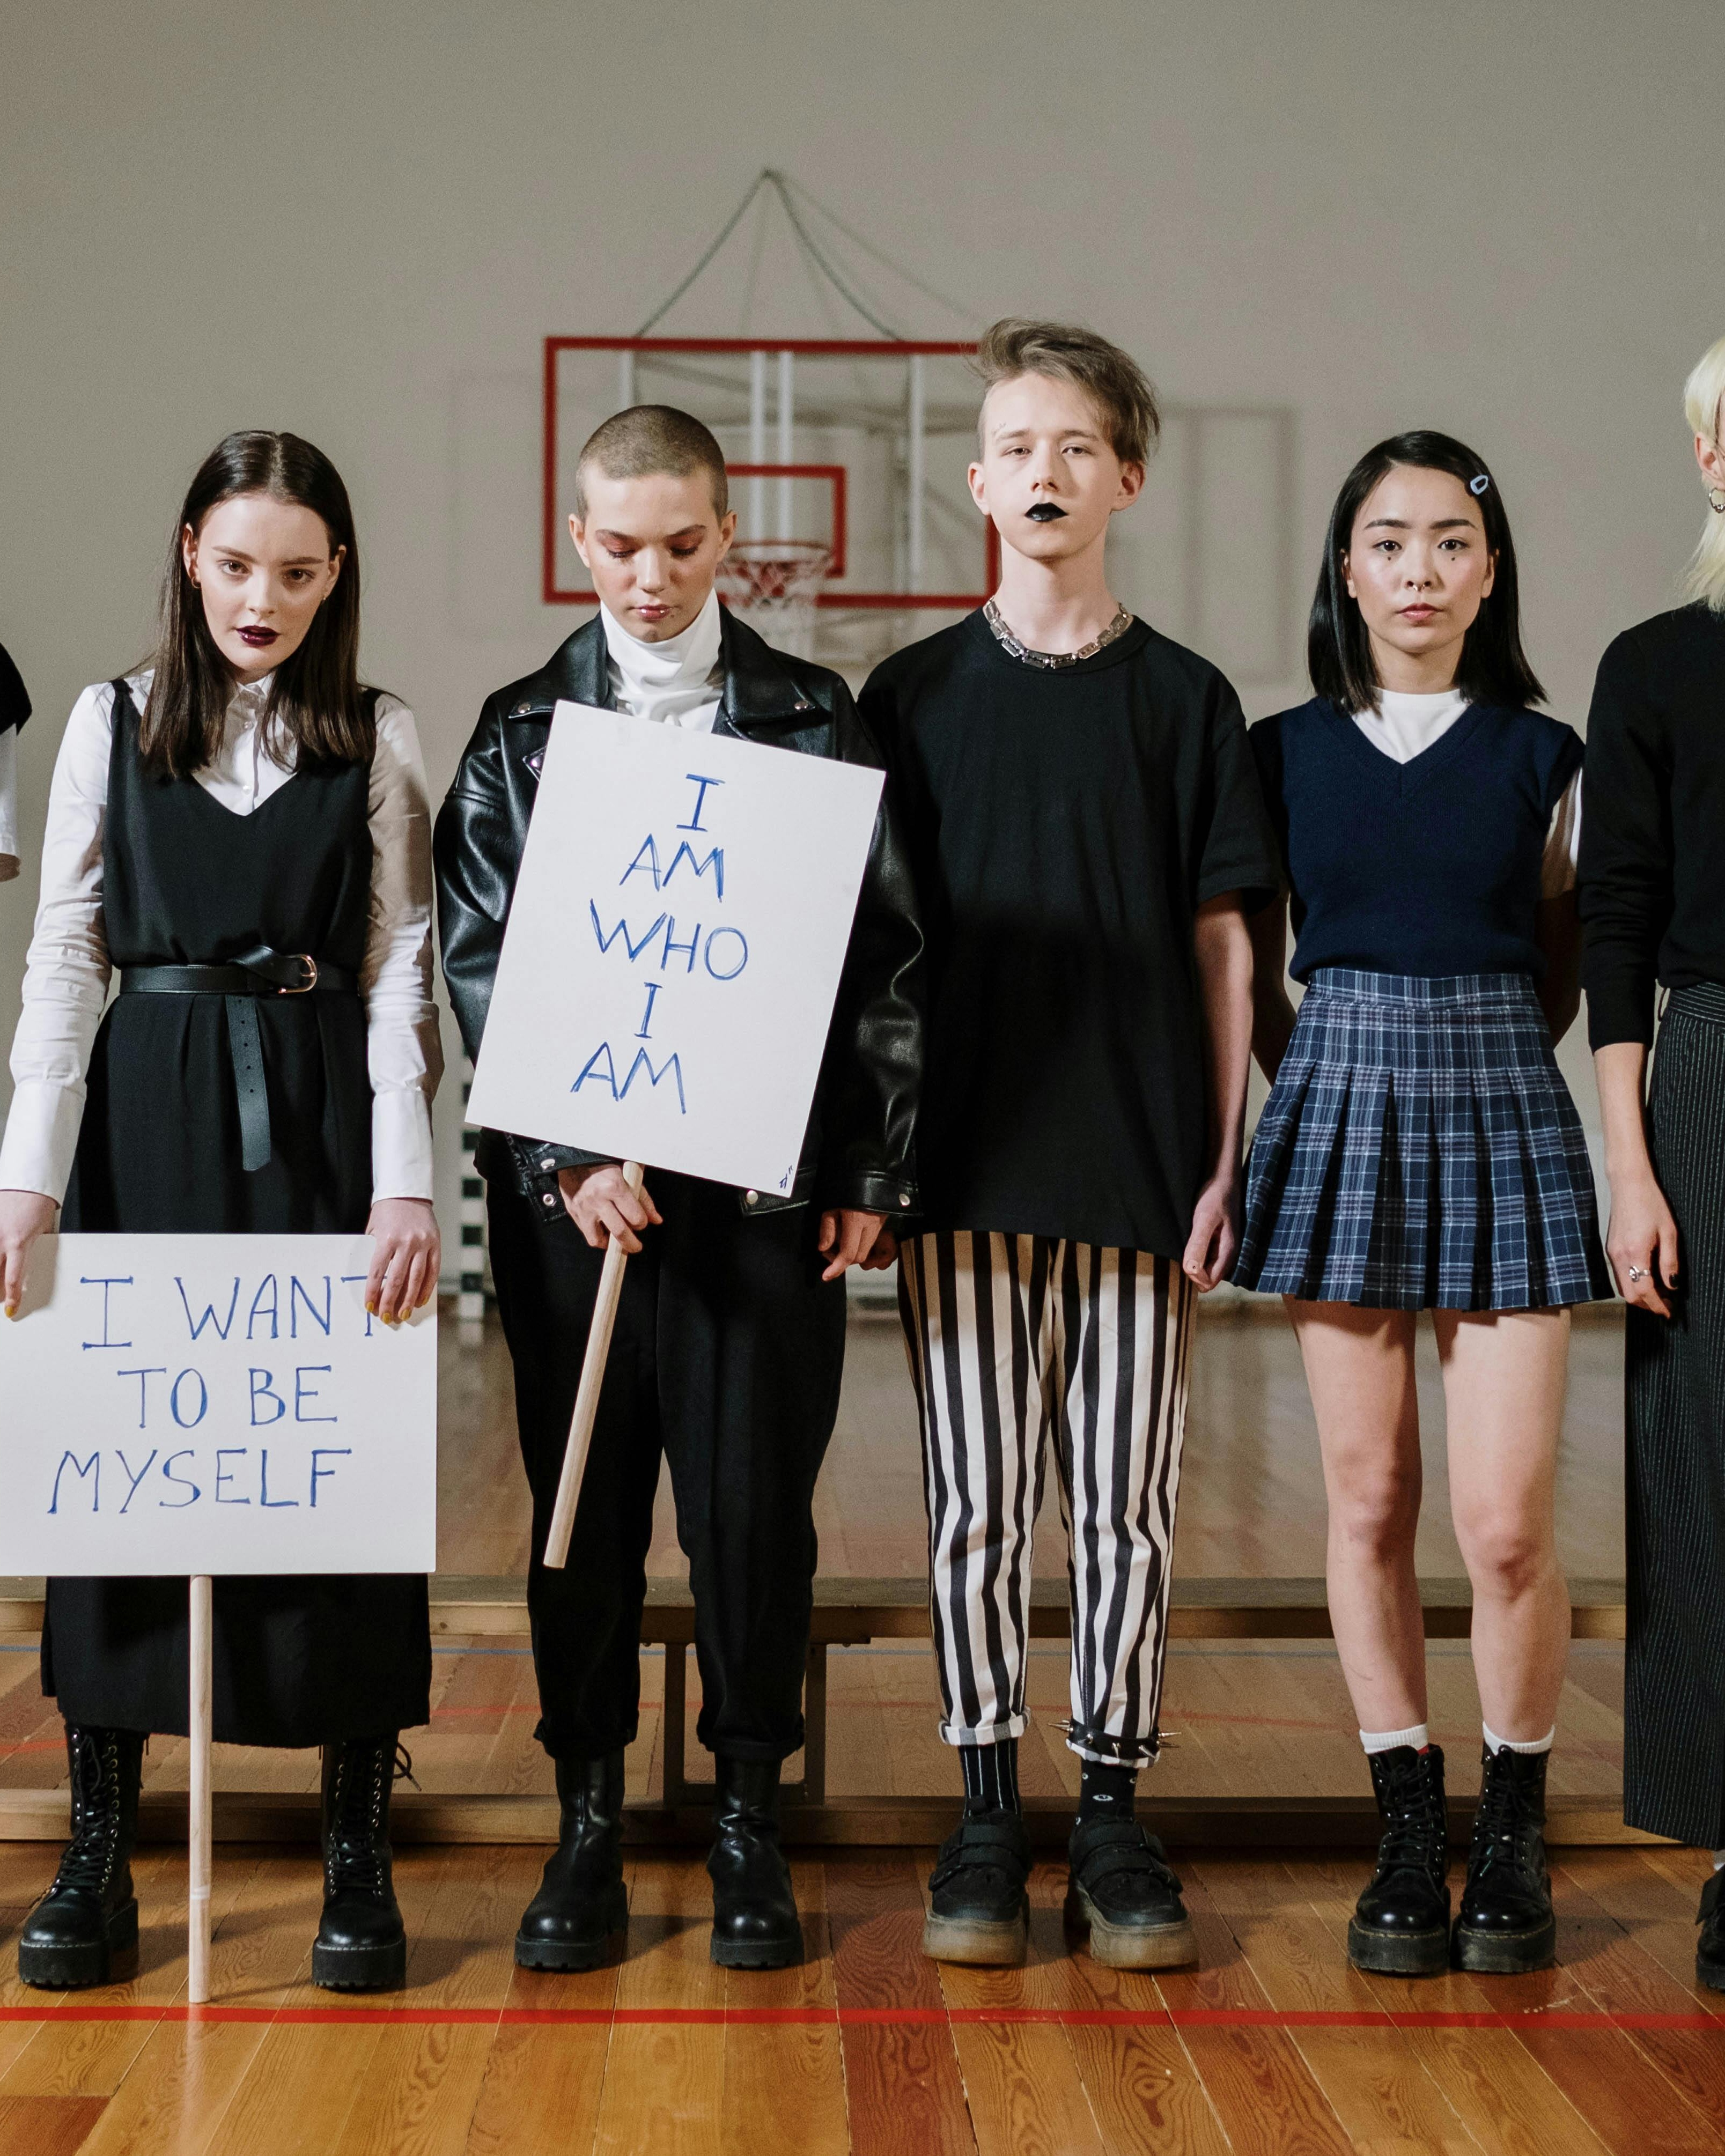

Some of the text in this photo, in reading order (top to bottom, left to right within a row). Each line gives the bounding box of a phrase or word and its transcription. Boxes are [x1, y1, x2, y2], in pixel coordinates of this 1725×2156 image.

[676, 773, 725, 832] I
[620, 833, 724, 902] AM
[589, 898, 748, 980] WHO
[635, 982, 662, 1039] I
[570, 1042, 686, 1114] AM
[80, 1275, 134, 1350] I
[117, 1365, 338, 1428] TO BE
[47, 1448, 352, 1514] MYSELF
